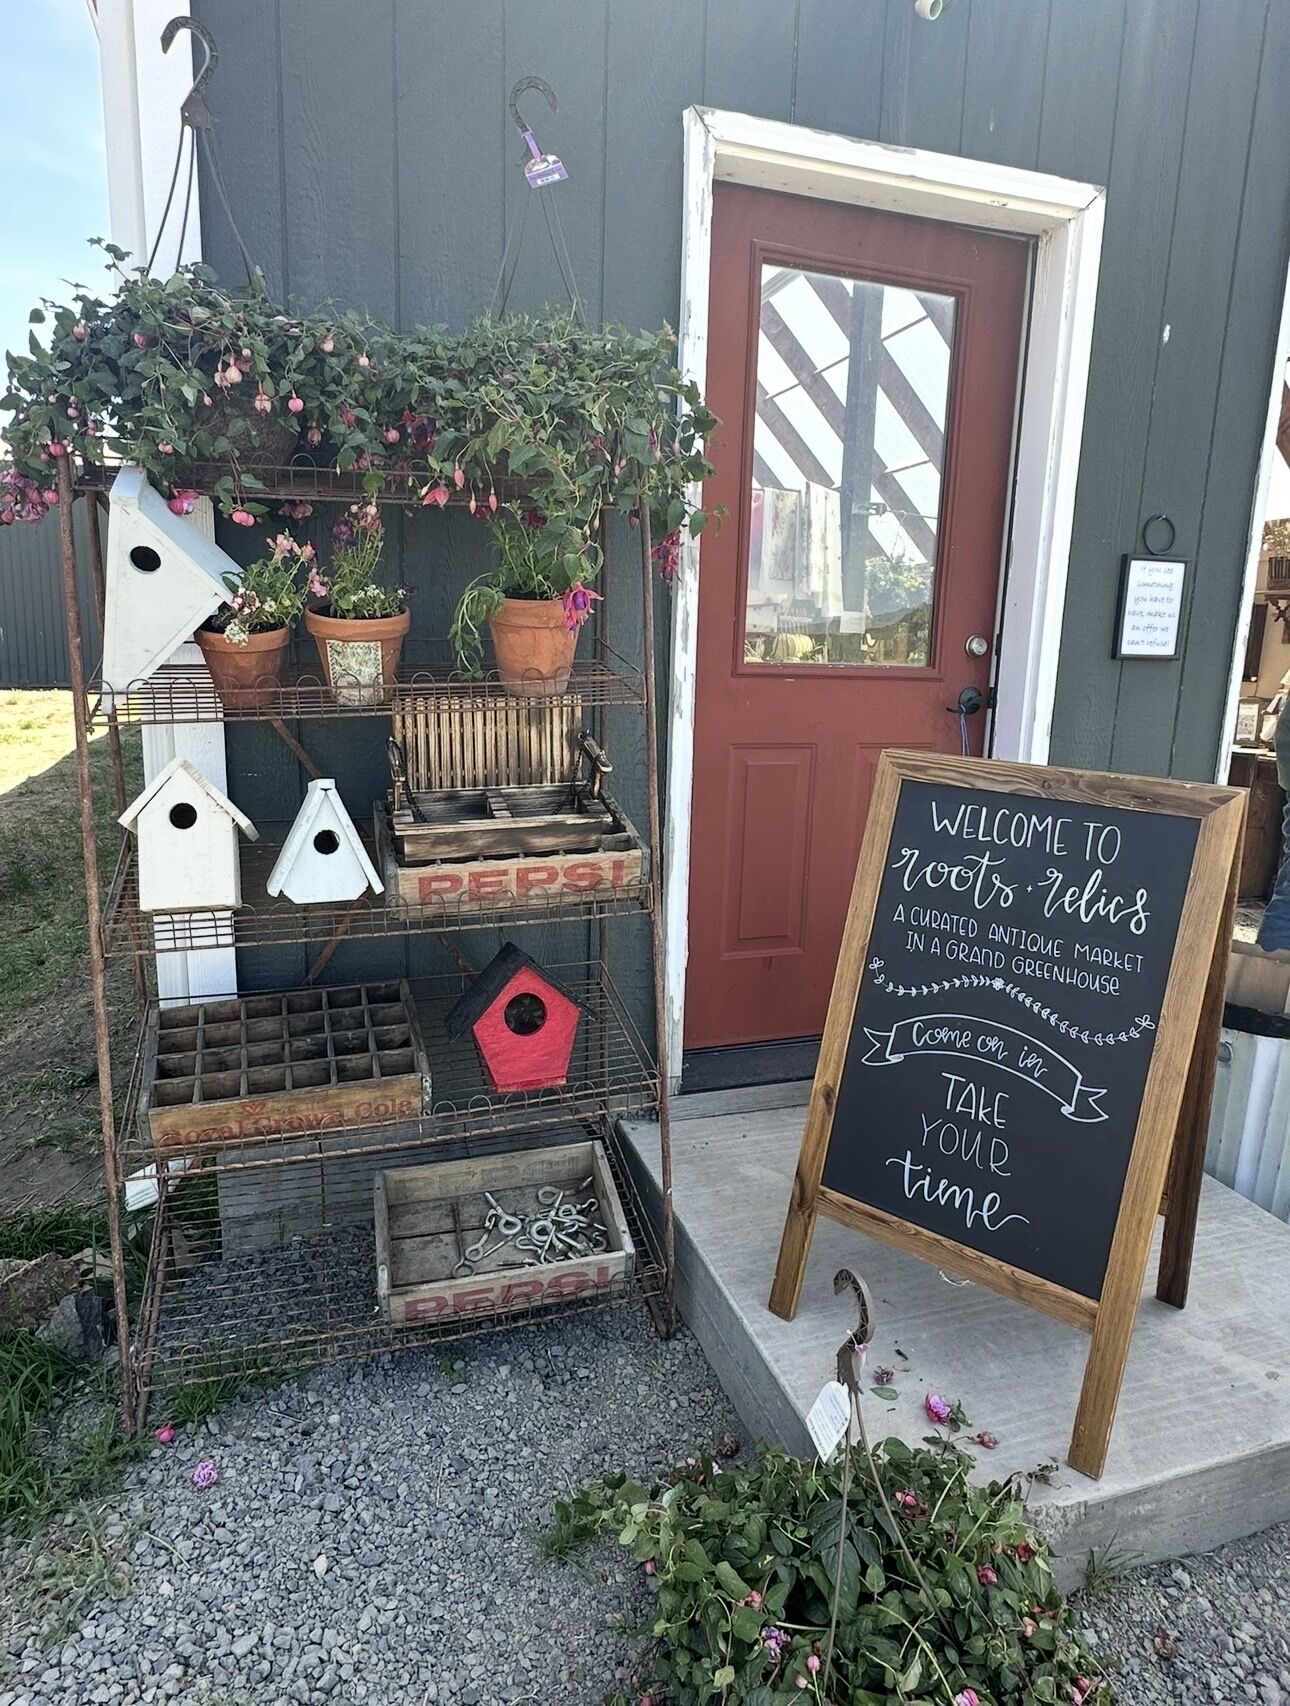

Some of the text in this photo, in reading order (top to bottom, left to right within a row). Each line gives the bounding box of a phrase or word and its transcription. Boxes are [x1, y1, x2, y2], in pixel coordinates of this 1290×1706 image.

[1133, 596, 1148, 605] you
[1137, 581, 1174, 591] something
[1147, 610, 1167, 618] make
[1142, 623, 1160, 634] offer
[931, 801, 1122, 865] WELCOME TO
[418, 860, 625, 906] PEPSI
[891, 847, 1019, 910] roots
[1037, 867, 1151, 935] relics
[893, 904, 1144, 973] A CURATED ANTIQUE MARKET
[905, 930, 1121, 996] IN A GRAND GREENHOUSE
[912, 1021, 1048, 1078] Come on in
[354, 1099, 413, 1121] Cola
[941, 1072, 1010, 1129] TAKE
[920, 1113, 1012, 1176] YOUR
[885, 1150, 1031, 1231] time
[405, 1265, 610, 1322] PEPSI
